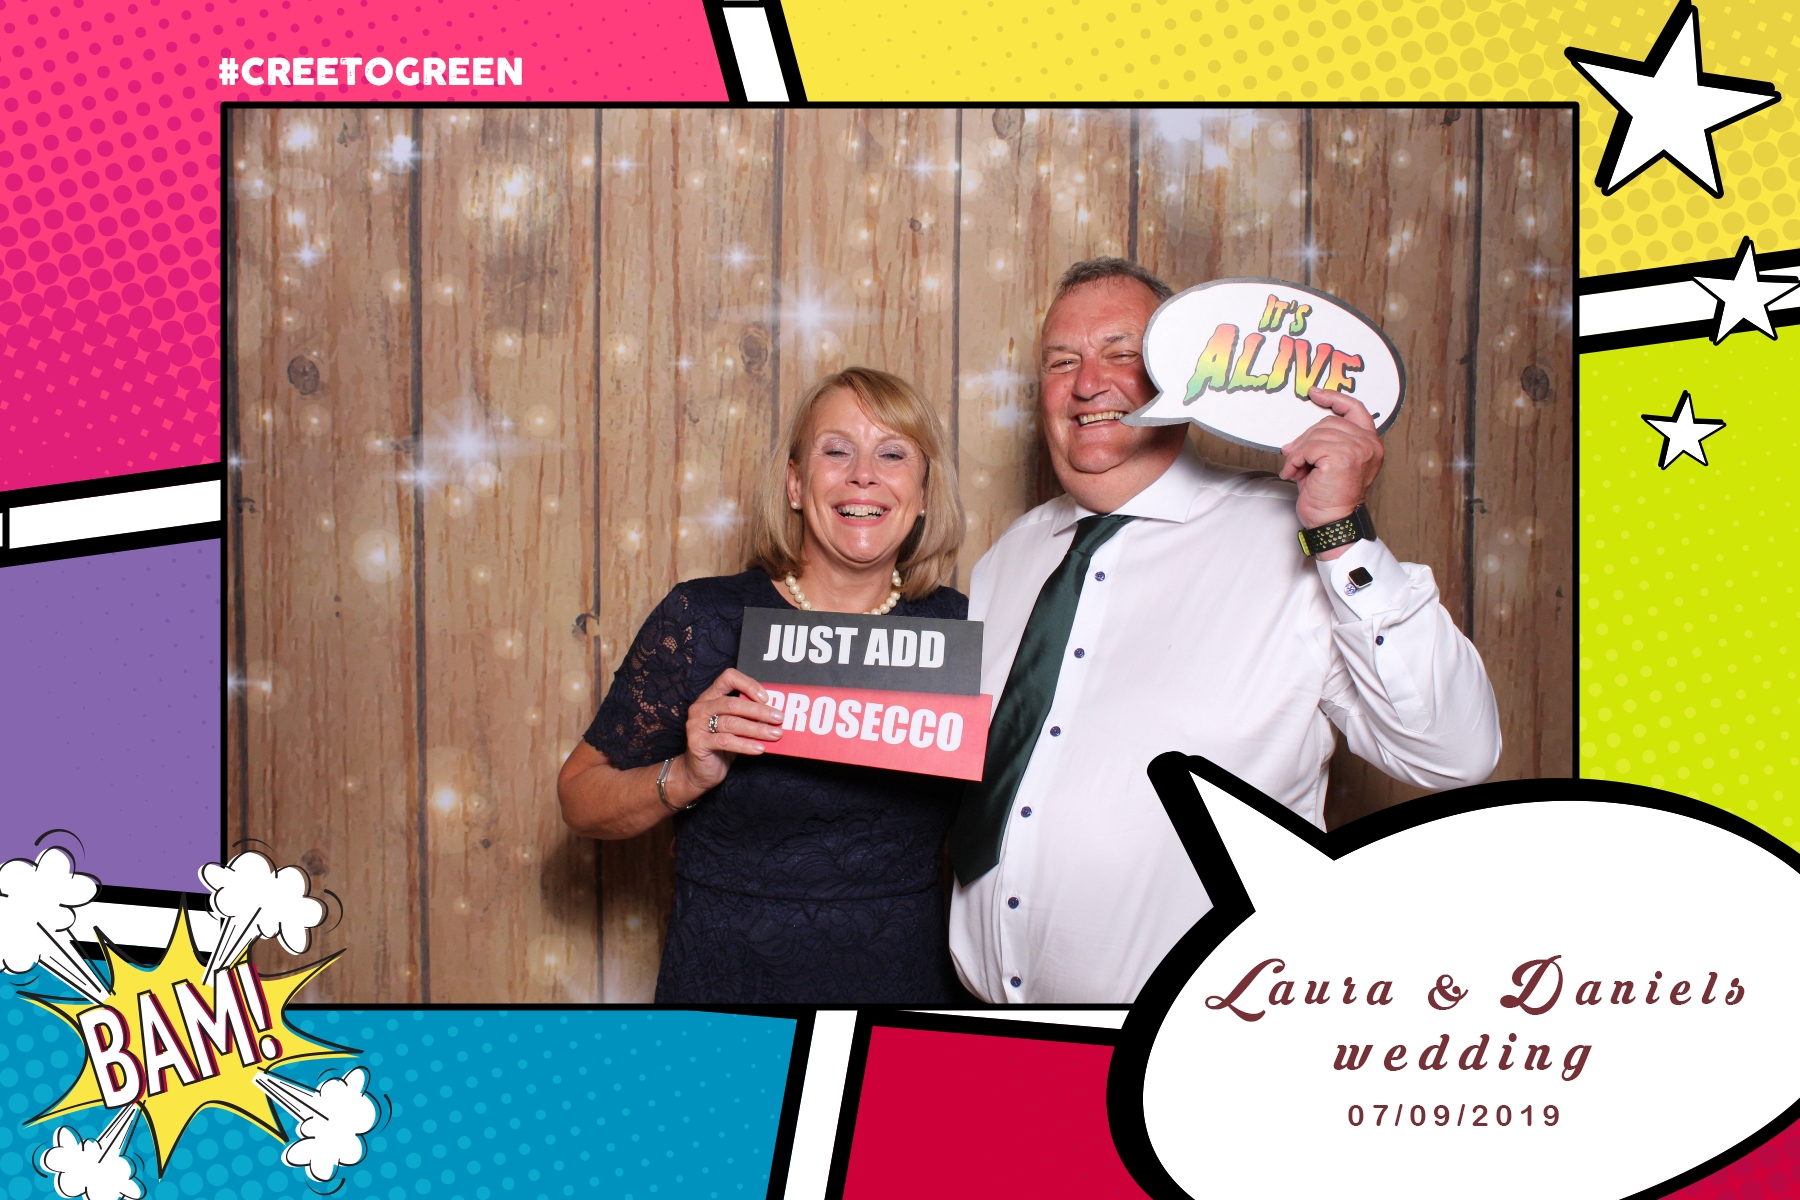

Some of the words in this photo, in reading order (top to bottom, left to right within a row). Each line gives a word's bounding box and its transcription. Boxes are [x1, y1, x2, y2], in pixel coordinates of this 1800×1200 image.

[1258, 293, 1312, 336] IT'S
[763, 624, 858, 665] JUST
[863, 628, 945, 668] ADD
